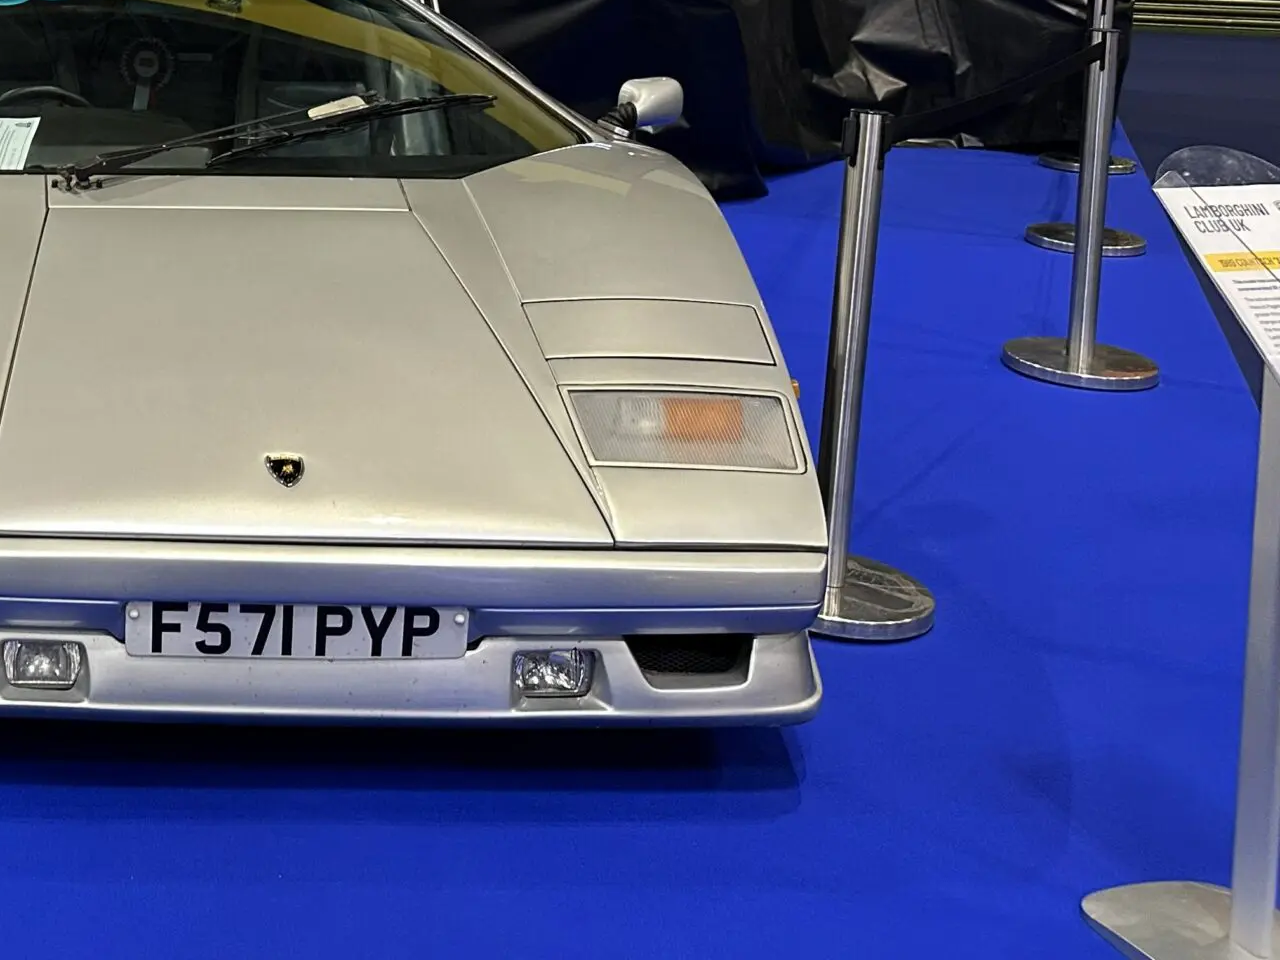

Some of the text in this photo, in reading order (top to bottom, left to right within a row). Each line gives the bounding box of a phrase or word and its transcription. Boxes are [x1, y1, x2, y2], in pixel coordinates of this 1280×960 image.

[1183, 203, 1270, 219] LAMBORGHINI
[1194, 219, 1252, 234] CLUB UK
[150, 601, 440, 657] F571 PYP
